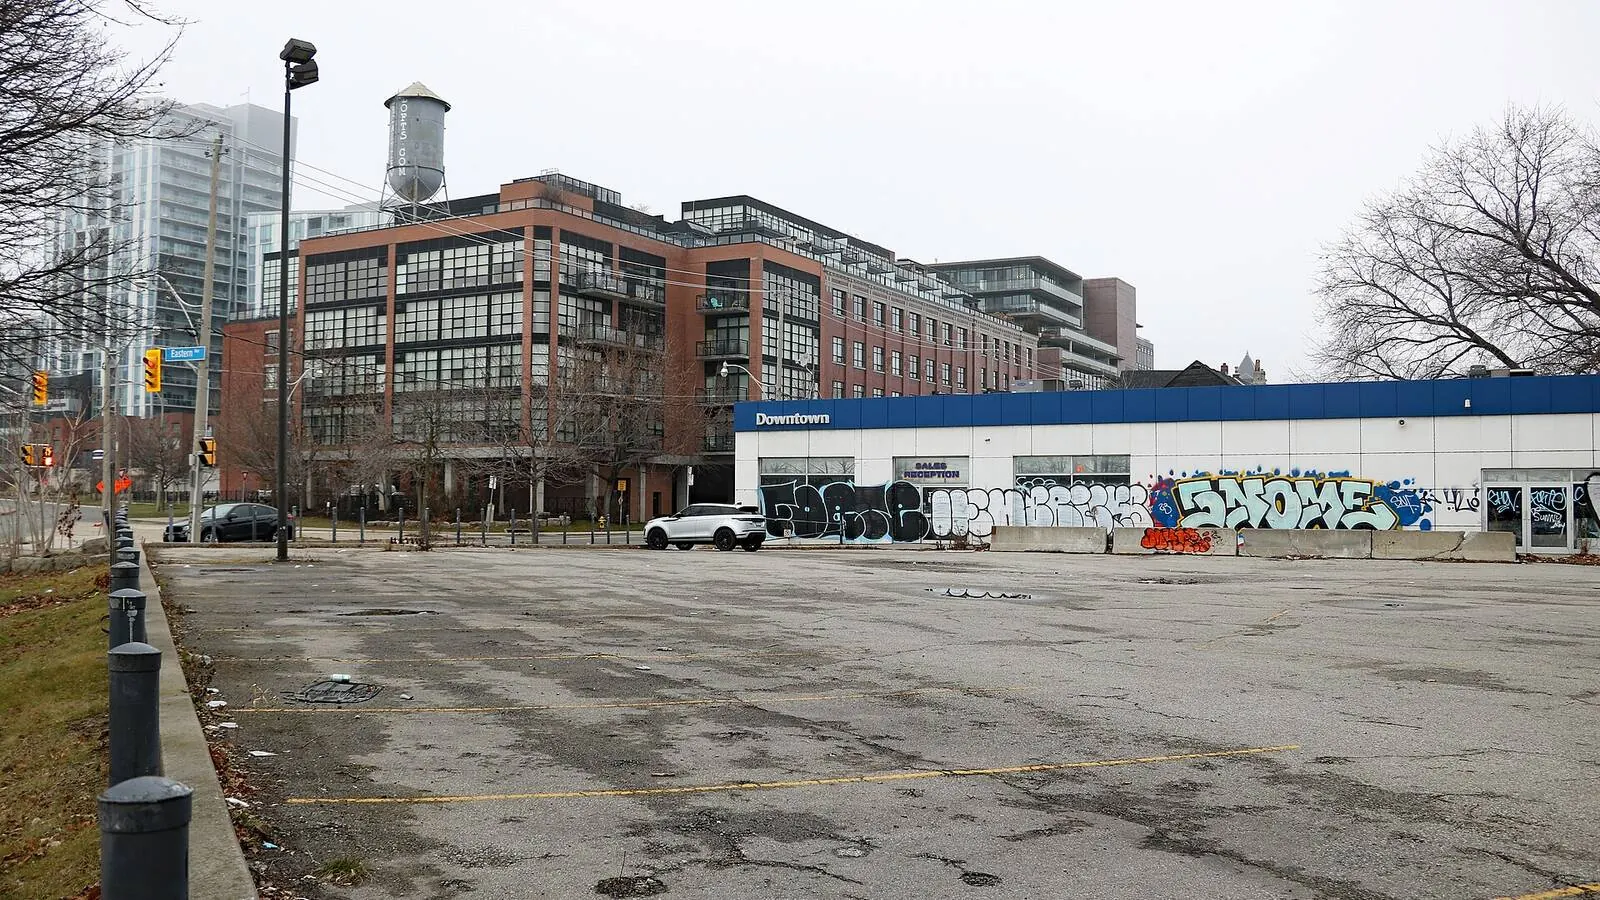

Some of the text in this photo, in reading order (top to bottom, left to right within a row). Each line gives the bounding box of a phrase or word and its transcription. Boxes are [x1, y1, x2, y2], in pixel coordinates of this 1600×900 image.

[170, 349, 193, 358] Eastern
[755, 412, 830, 426] Downtown
[915, 462, 948, 470] SALES
[903, 470, 960, 479] RECEPTION
